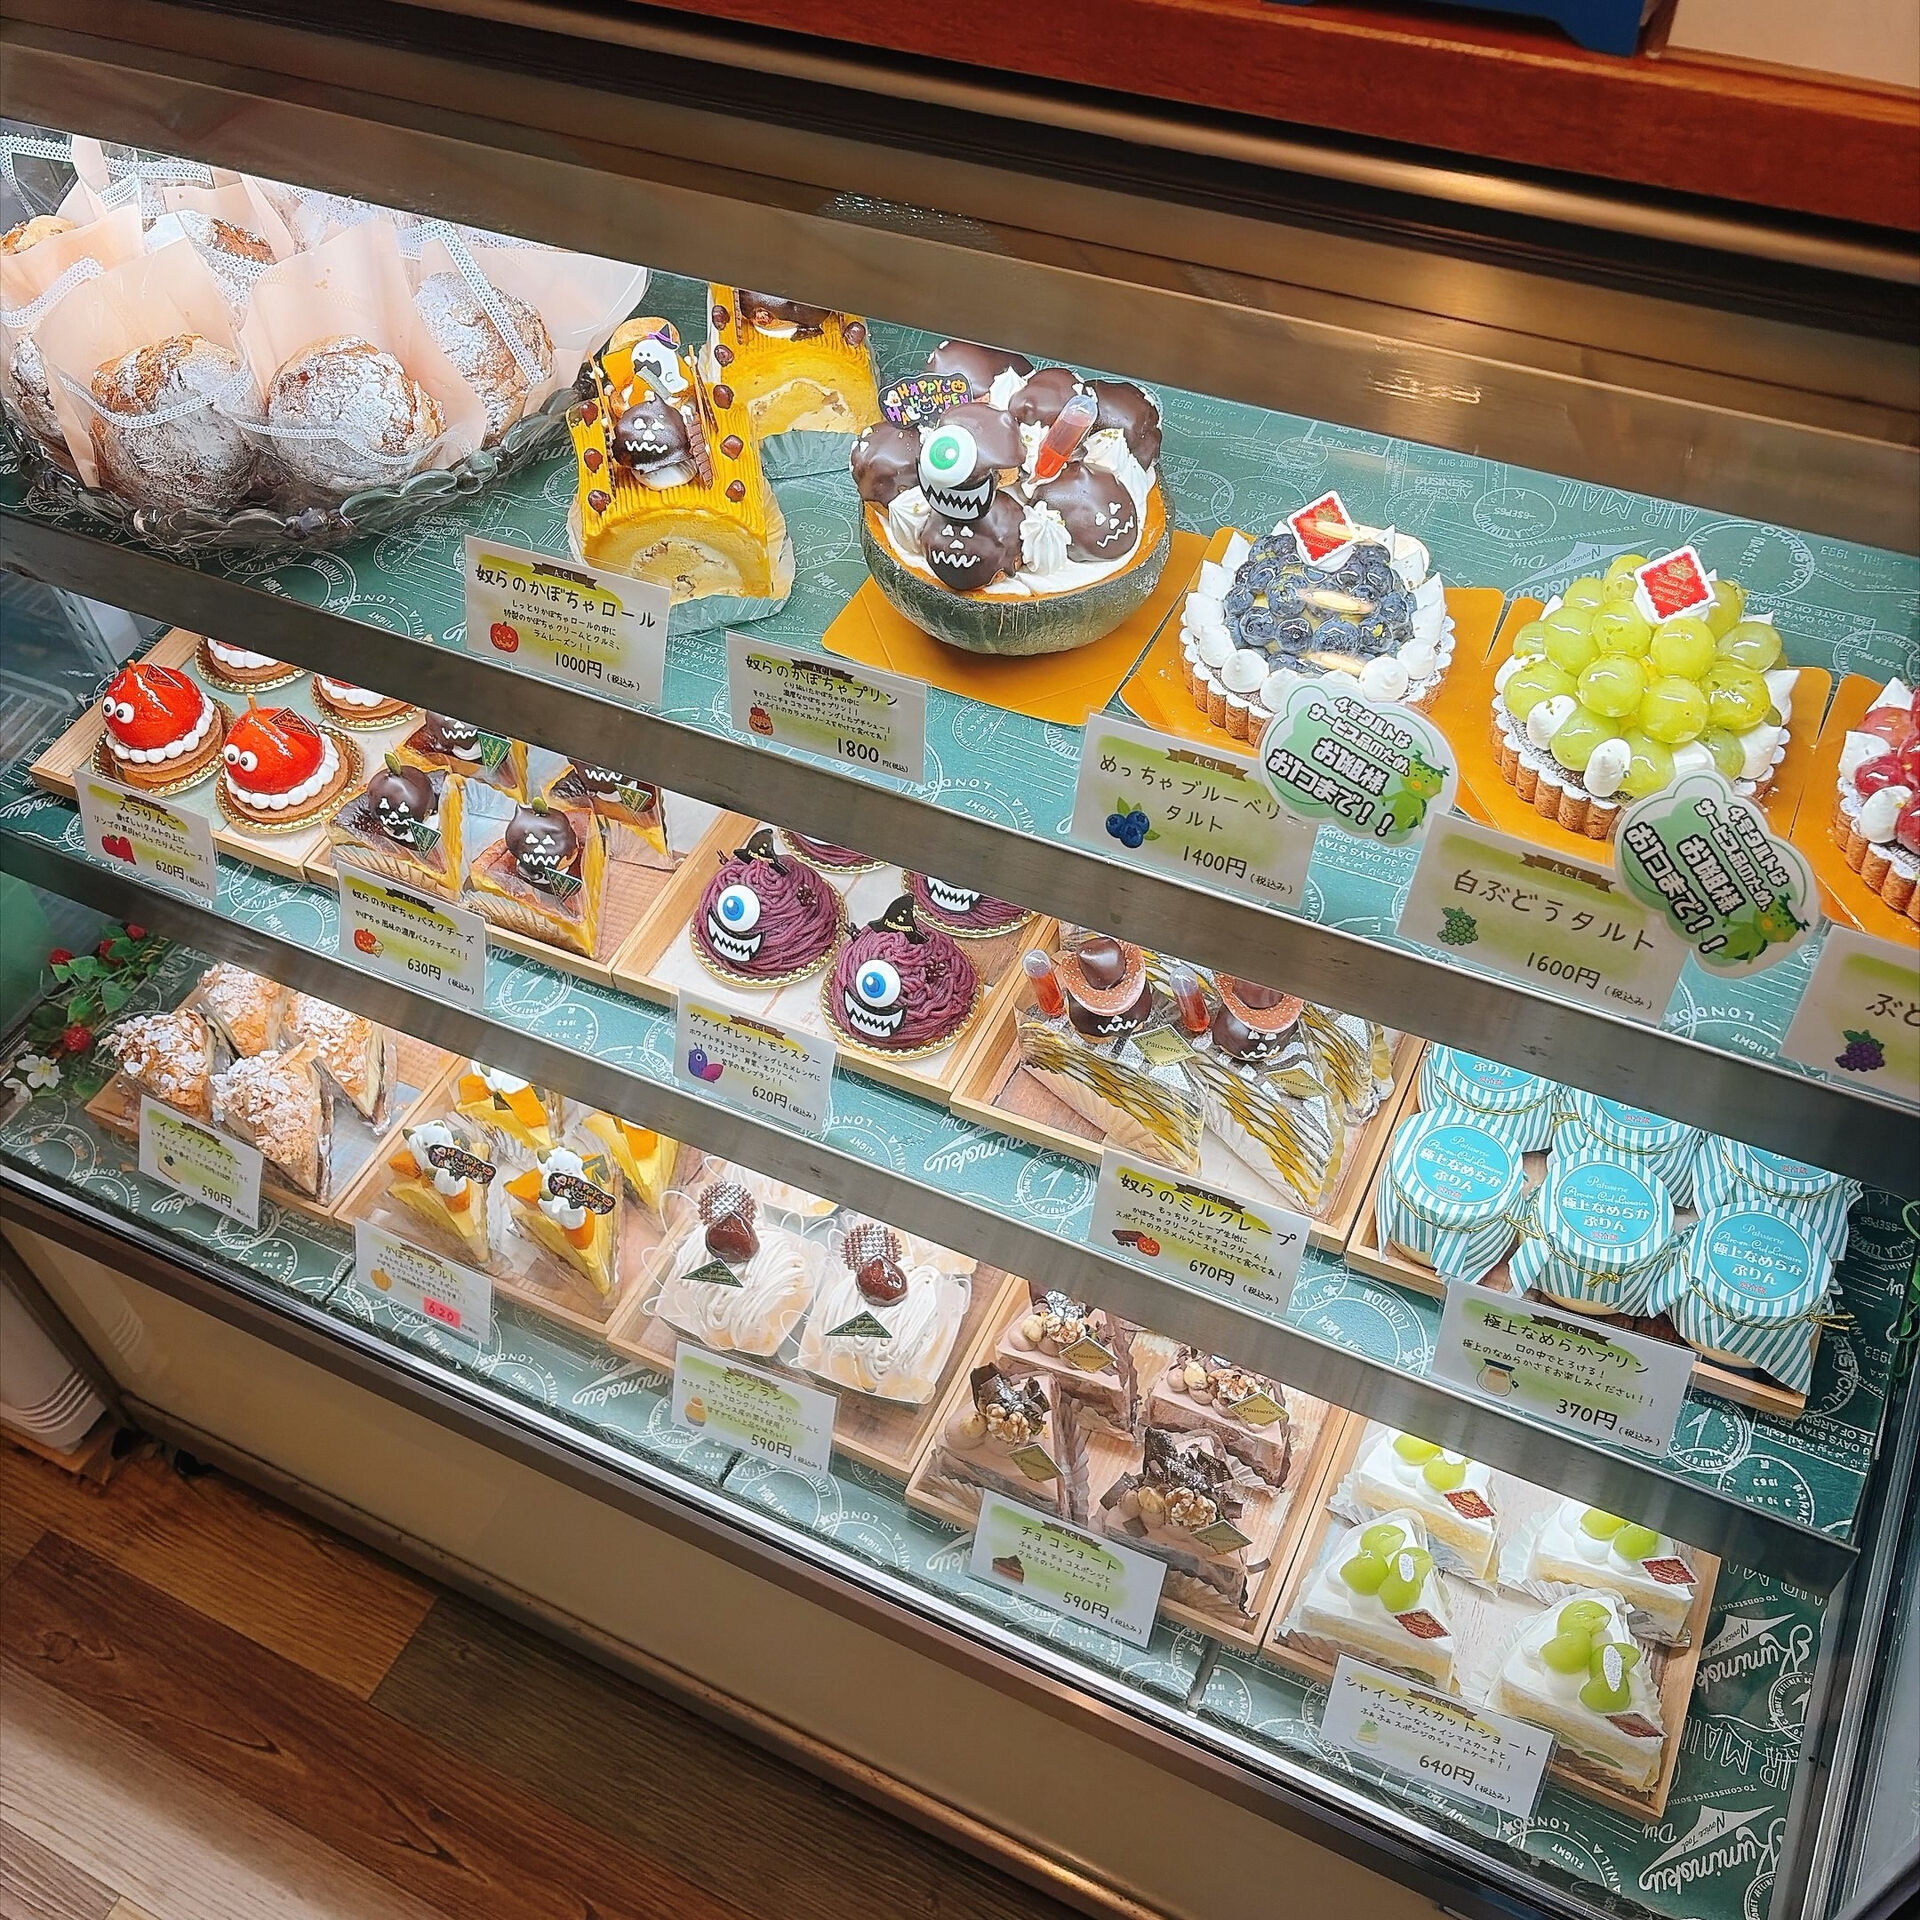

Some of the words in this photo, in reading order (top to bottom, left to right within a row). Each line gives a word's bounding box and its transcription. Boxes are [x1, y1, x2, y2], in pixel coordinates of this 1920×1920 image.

[897, 379, 943, 400] HAPPY
[1557, 479, 1636, 521] MAIL
[1570, 528, 1622, 542] construct
[476, 564, 656, 628] 奴らのかぼちゃロール
[512, 599, 617, 636] しっとりかぼちゃロールの中に
[555, 652, 603, 679] 1000円
[745, 655, 898, 706] 奴らのかぼちゃプリン
[1334, 696, 1412, 749] 4号タルトは
[837, 737, 879, 763] 1800
[1307, 703, 1411, 777] サービス品のため、
[1194, 756, 1221, 771] A.C.L
[1166, 805, 1223, 833] タルト
[1317, 838, 1348, 854] STAY
[1350, 849, 1382, 863] DAYS
[1728, 805, 1790, 888] 4号タルトは
[155, 860, 185, 881] 620円
[1183, 846, 1247, 879] 1400円
[1250, 873, 1293, 894] (税込み)
[1551, 862, 1583, 881] A.C.L
[351, 888, 475, 944] 奴らのかぼちゃバスクチーズ
[1453, 869, 1655, 951] 白ぶどうタルト
[407, 958, 442, 981] 630円
[1527, 951, 1601, 990] 1600円
[1604, 985, 1653, 1009] (税込み)
[690, 1011, 822, 1066] ヴァイオレットモンスター
[1730, 1032, 1776, 1059] FLIGHT
[752, 1085, 788, 1109] 620円
[1420, 1147, 1502, 1188] 極上なめらか
[201, 1184, 232, 1209] 590円
[1121, 1174, 1296, 1246] 奴らのミルクレープ
[1561, 1196, 1650, 1220] 極上なめらか
[1158, 1206, 1248, 1245] もっちりクレープ生地に
[1583, 1214, 1627, 1233] ぷりん
[385, 1245, 457, 1283] かぼちゃタルト
[1713, 1241, 1802, 1276] 極上なめらか
[1189, 1259, 1235, 1287] 670円
[1732, 1263, 1777, 1286] ぷりん
[428, 1302, 454, 1321] 620
[1362, 1288, 1410, 1331] LONDON
[1556, 1321, 1583, 1336] A.C.L
[1483, 1312, 1649, 1374] 極上なめらかプリン
[721, 1371, 782, 1401] モンブラン
[1555, 1398, 1618, 1432] 370円
[1618, 1426, 1661, 1447] (税込み)
[751, 1434, 792, 1459] 590円
[1021, 1526, 1117, 1571] チョコショート
[1062, 1591, 1109, 1619] 590円
[1344, 1676, 1537, 1757] シャインマスカットショート
[1419, 1754, 1475, 1786] 640円
[1692, 1786, 1741, 1803] construct
[1641, 1821, 1678, 1844] Diy
[1697, 1812, 1727, 1836] Novice
[1551, 1843, 1585, 1869] FLIGHT
